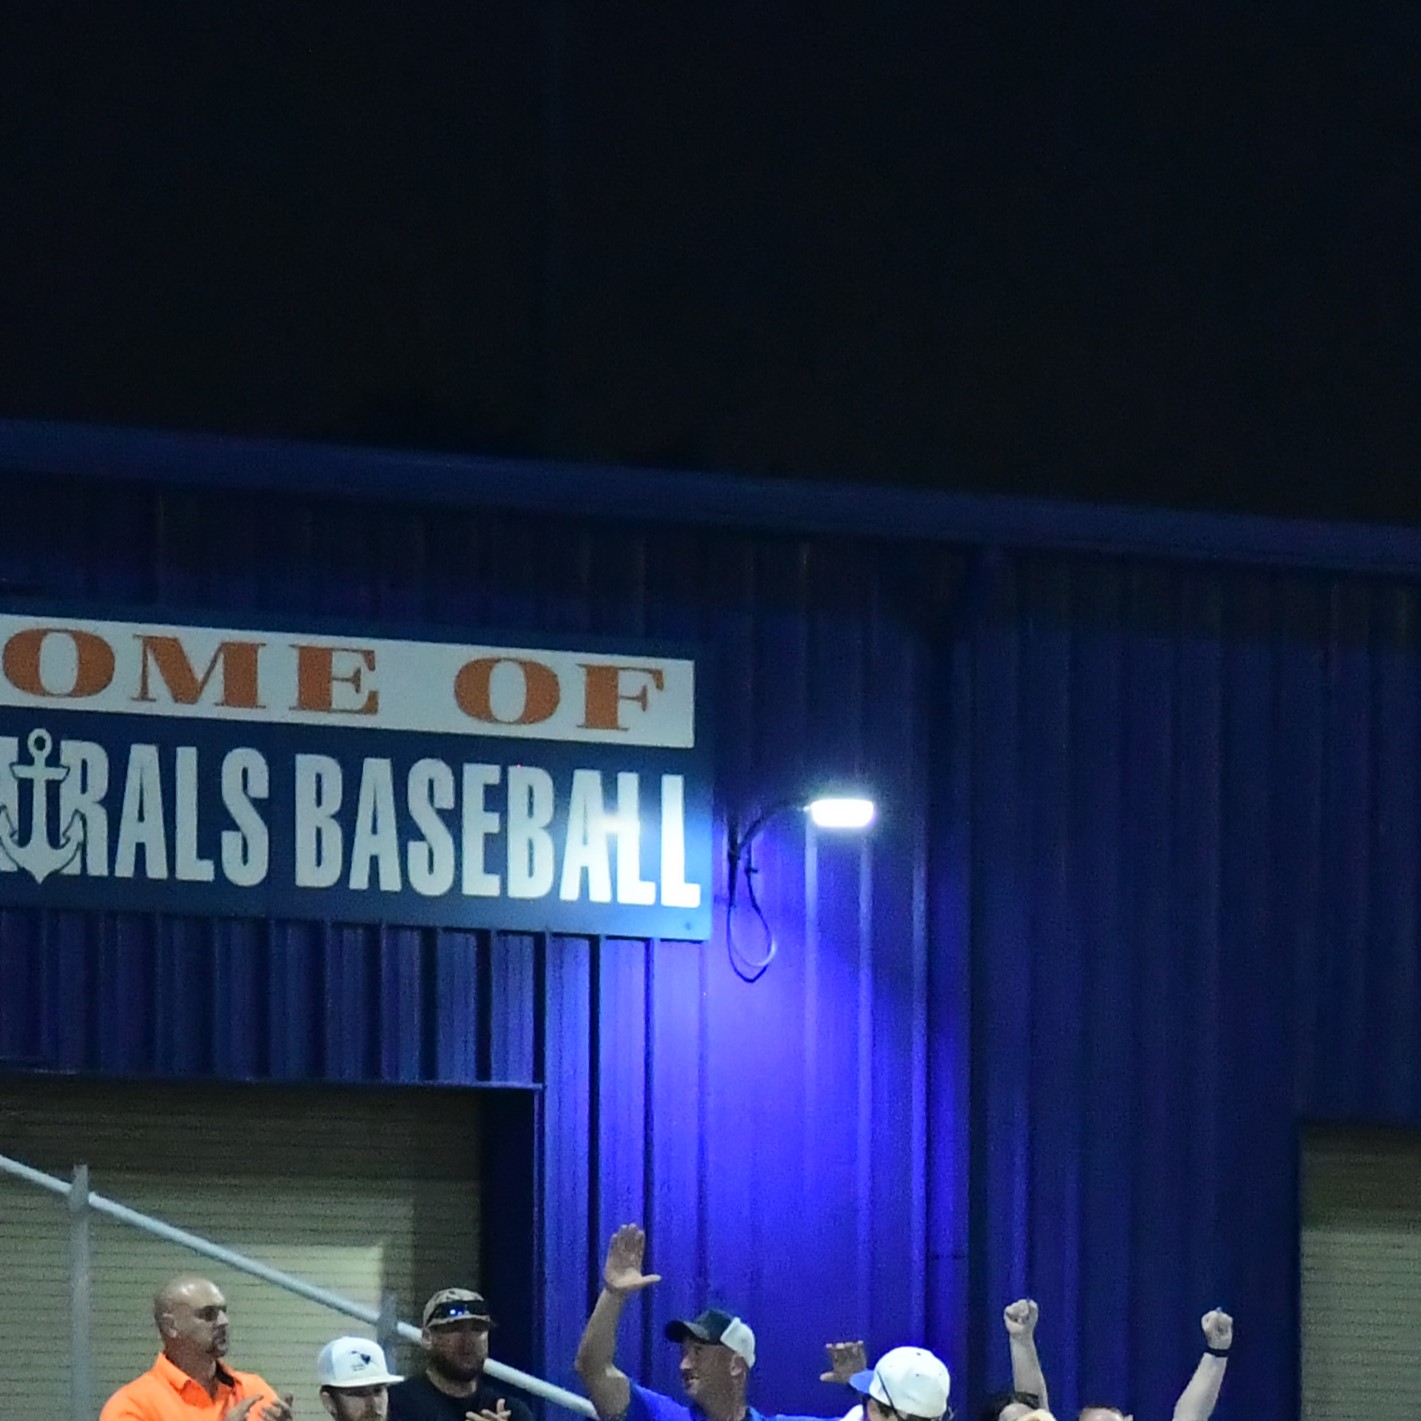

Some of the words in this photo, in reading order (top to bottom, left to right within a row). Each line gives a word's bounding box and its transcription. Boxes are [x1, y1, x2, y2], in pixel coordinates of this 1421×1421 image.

[2, 628, 379, 716] OME
[454, 656, 665, 732] OF
[295, 752, 701, 908] BASEBALL
